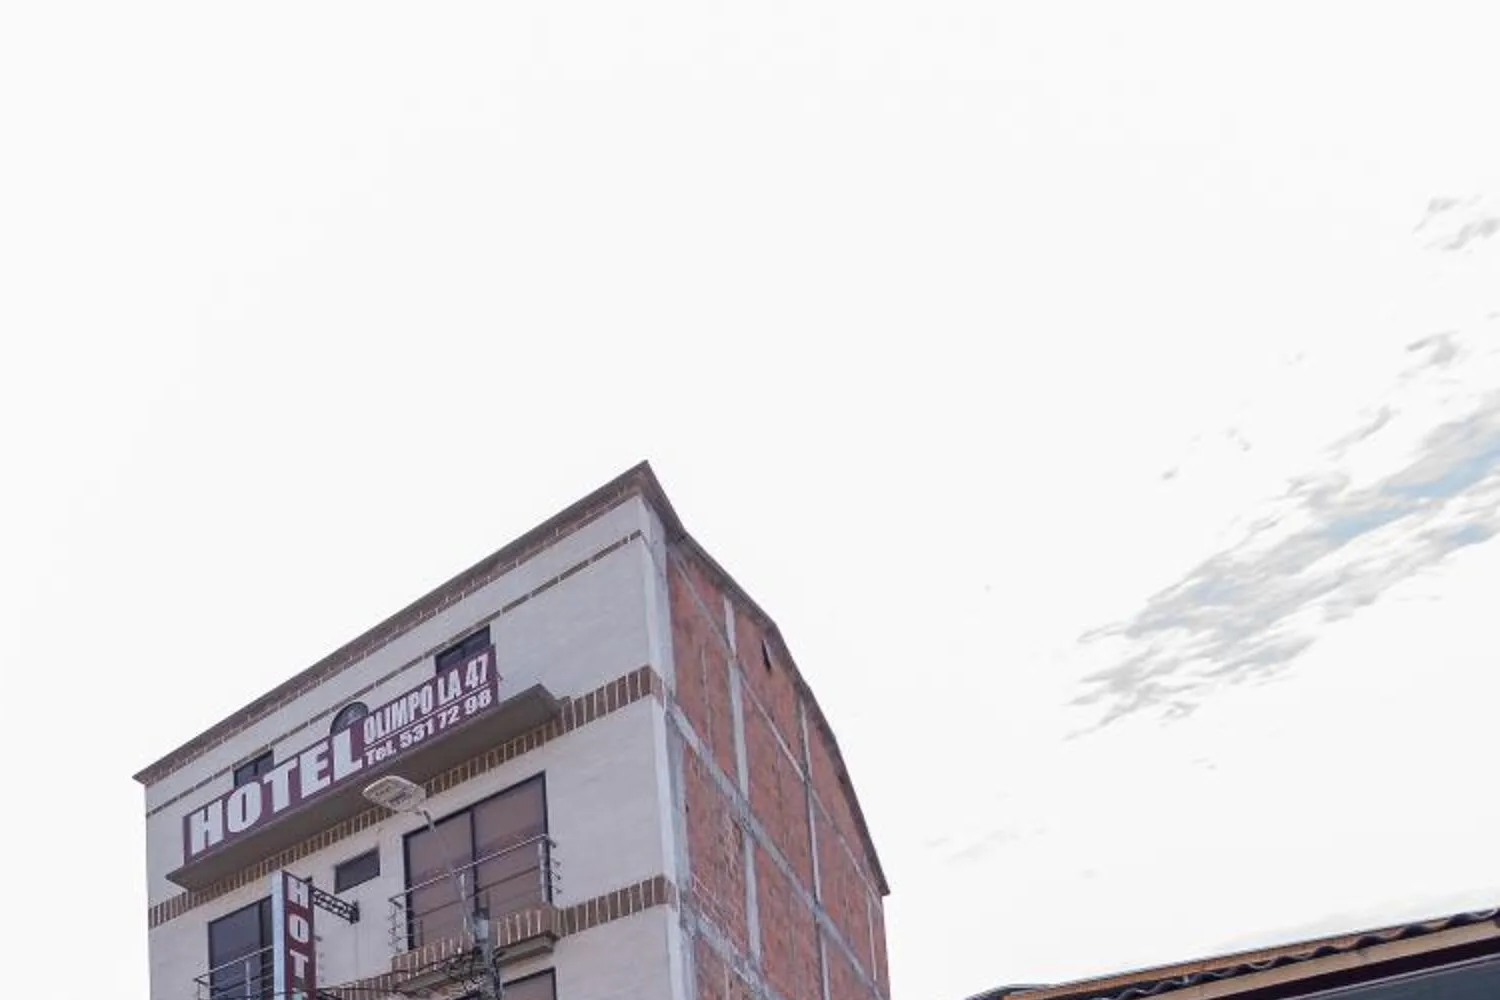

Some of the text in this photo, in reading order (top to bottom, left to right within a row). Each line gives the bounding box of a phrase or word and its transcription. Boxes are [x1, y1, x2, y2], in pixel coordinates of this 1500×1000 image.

[363, 653, 489, 745] OLIMPO LA 47
[400, 718, 434, 748] 531
[438, 706, 460, 729] 72
[464, 688, 492, 715] 98
[190, 727, 363, 857] HOTEL
